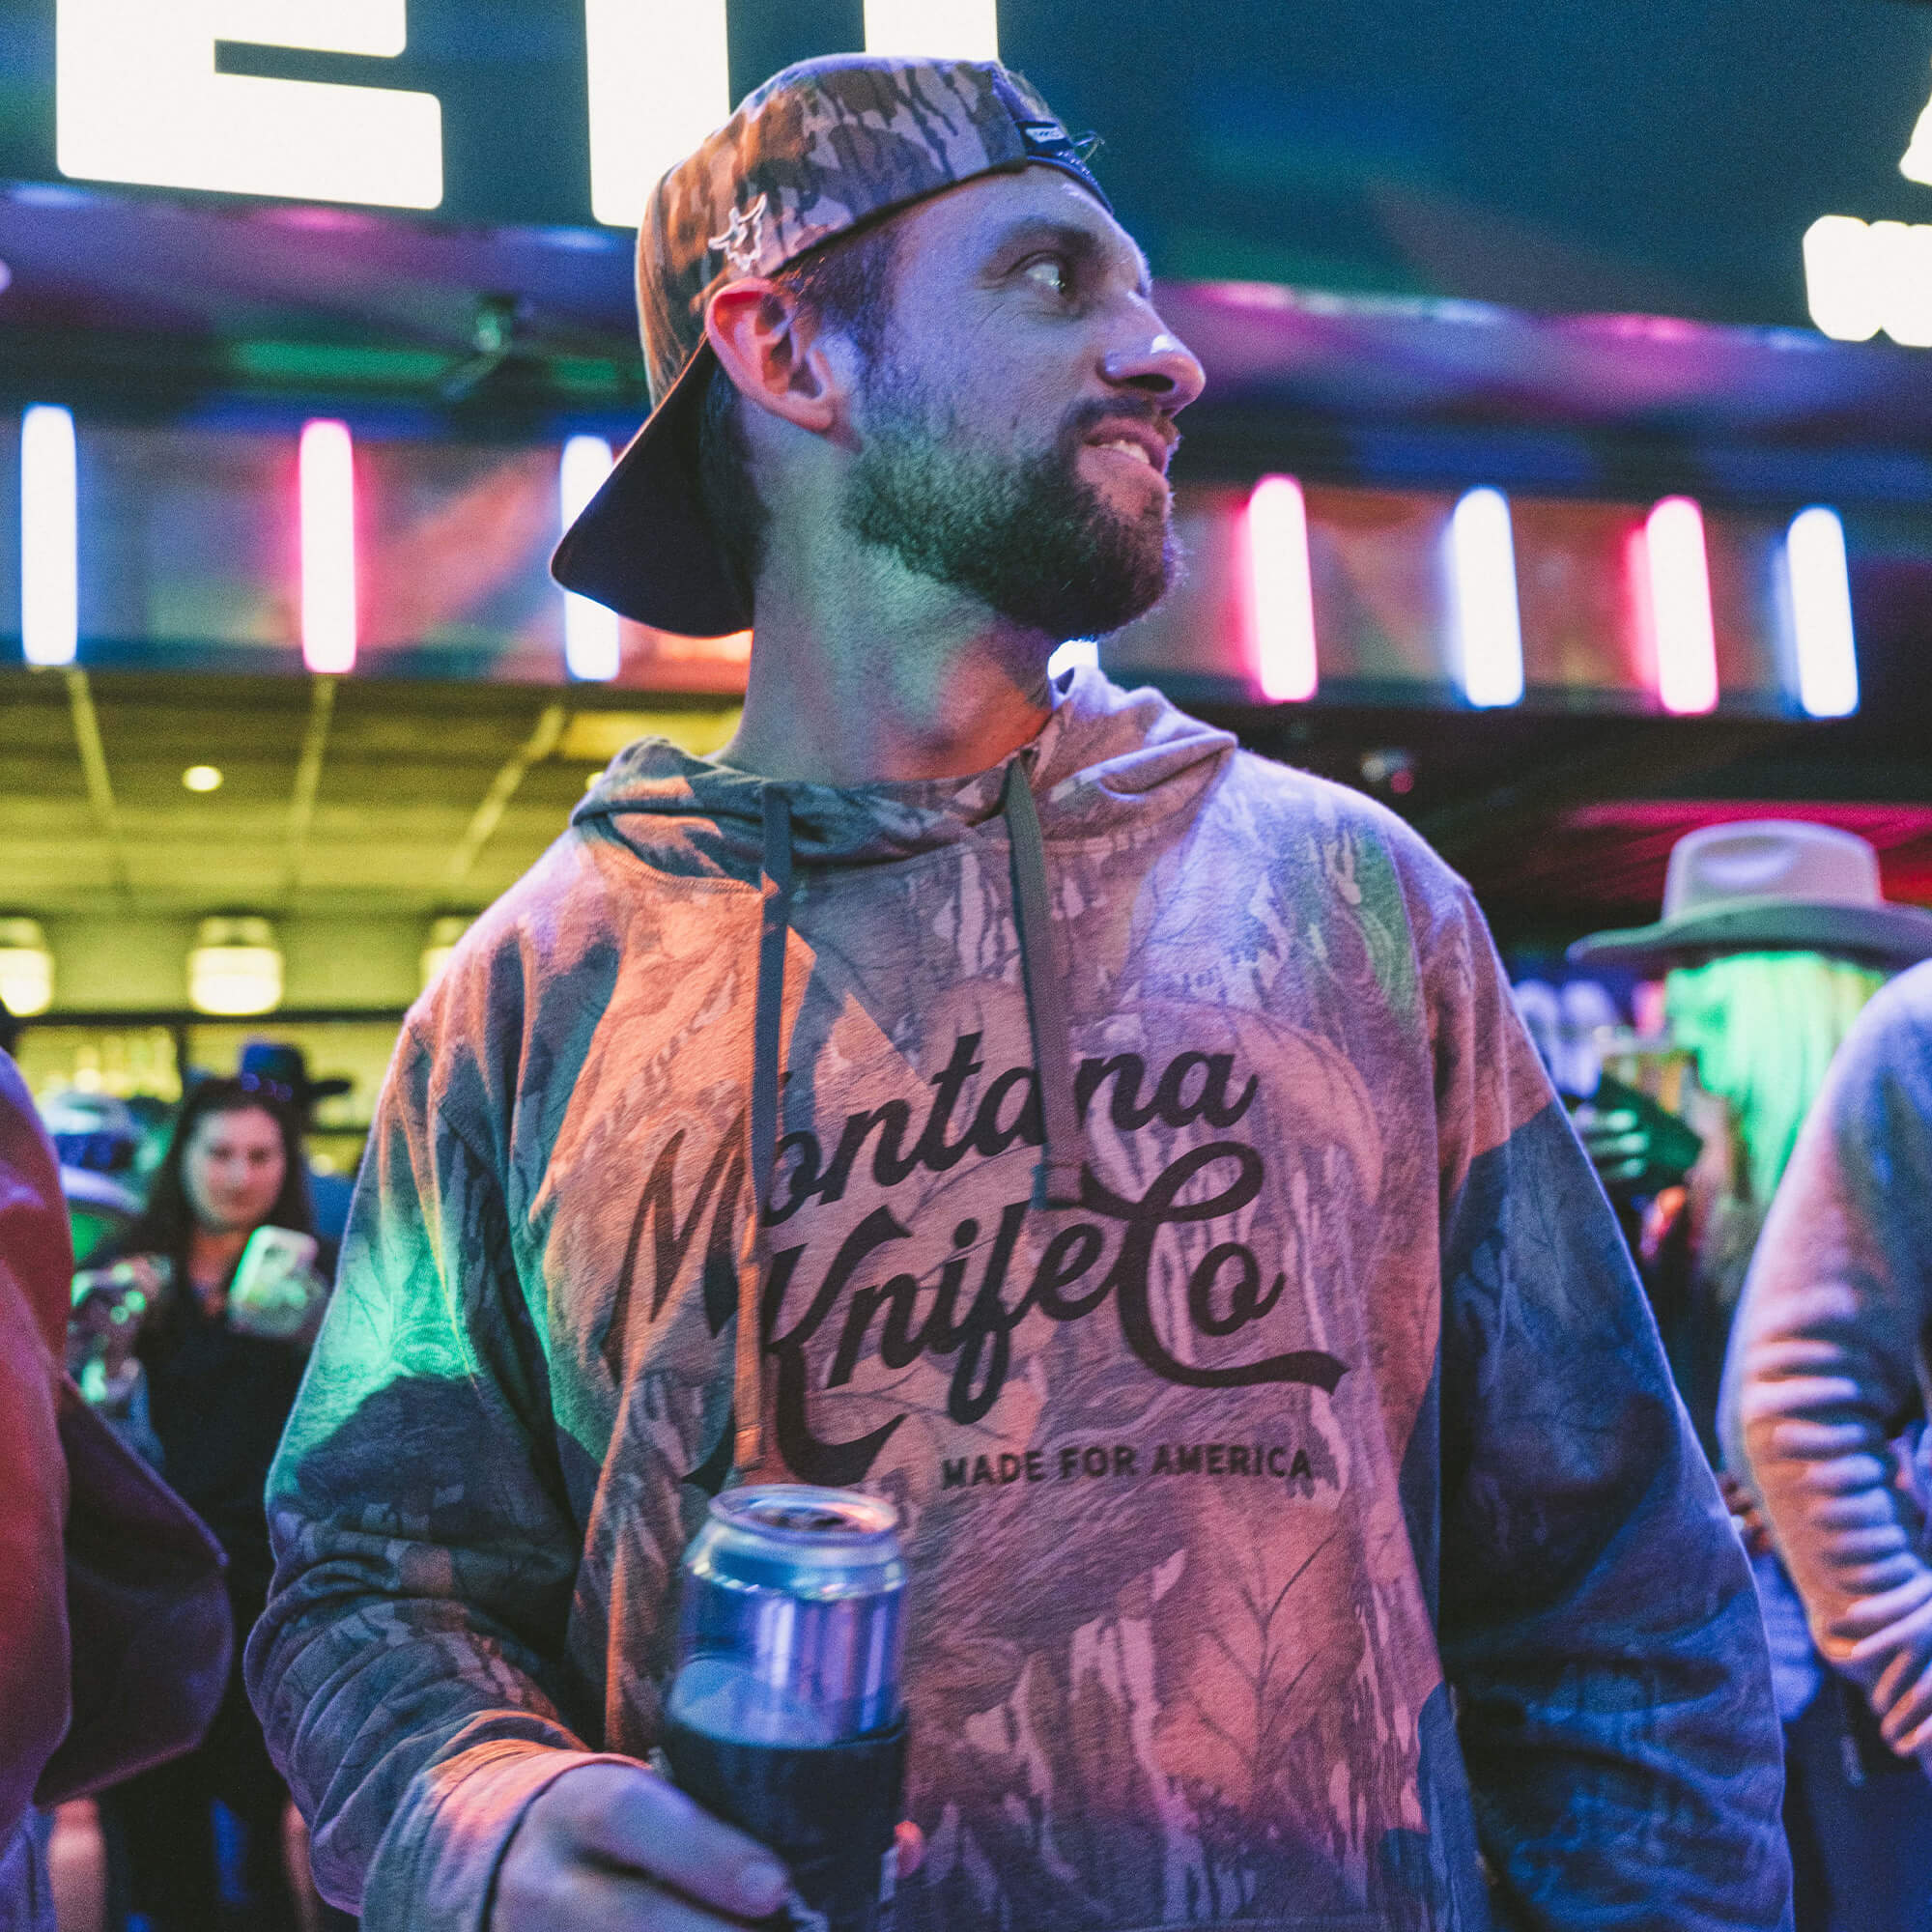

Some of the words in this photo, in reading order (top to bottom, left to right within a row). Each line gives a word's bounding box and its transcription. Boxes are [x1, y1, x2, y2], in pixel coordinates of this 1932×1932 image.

[597, 1028, 1260, 1389] Montana
[757, 1203, 1117, 1489] Knife
[941, 1450, 1045, 1491] MADE
[1061, 1445, 1139, 1480] FOR
[1151, 1442, 1317, 1482] AMERICA
